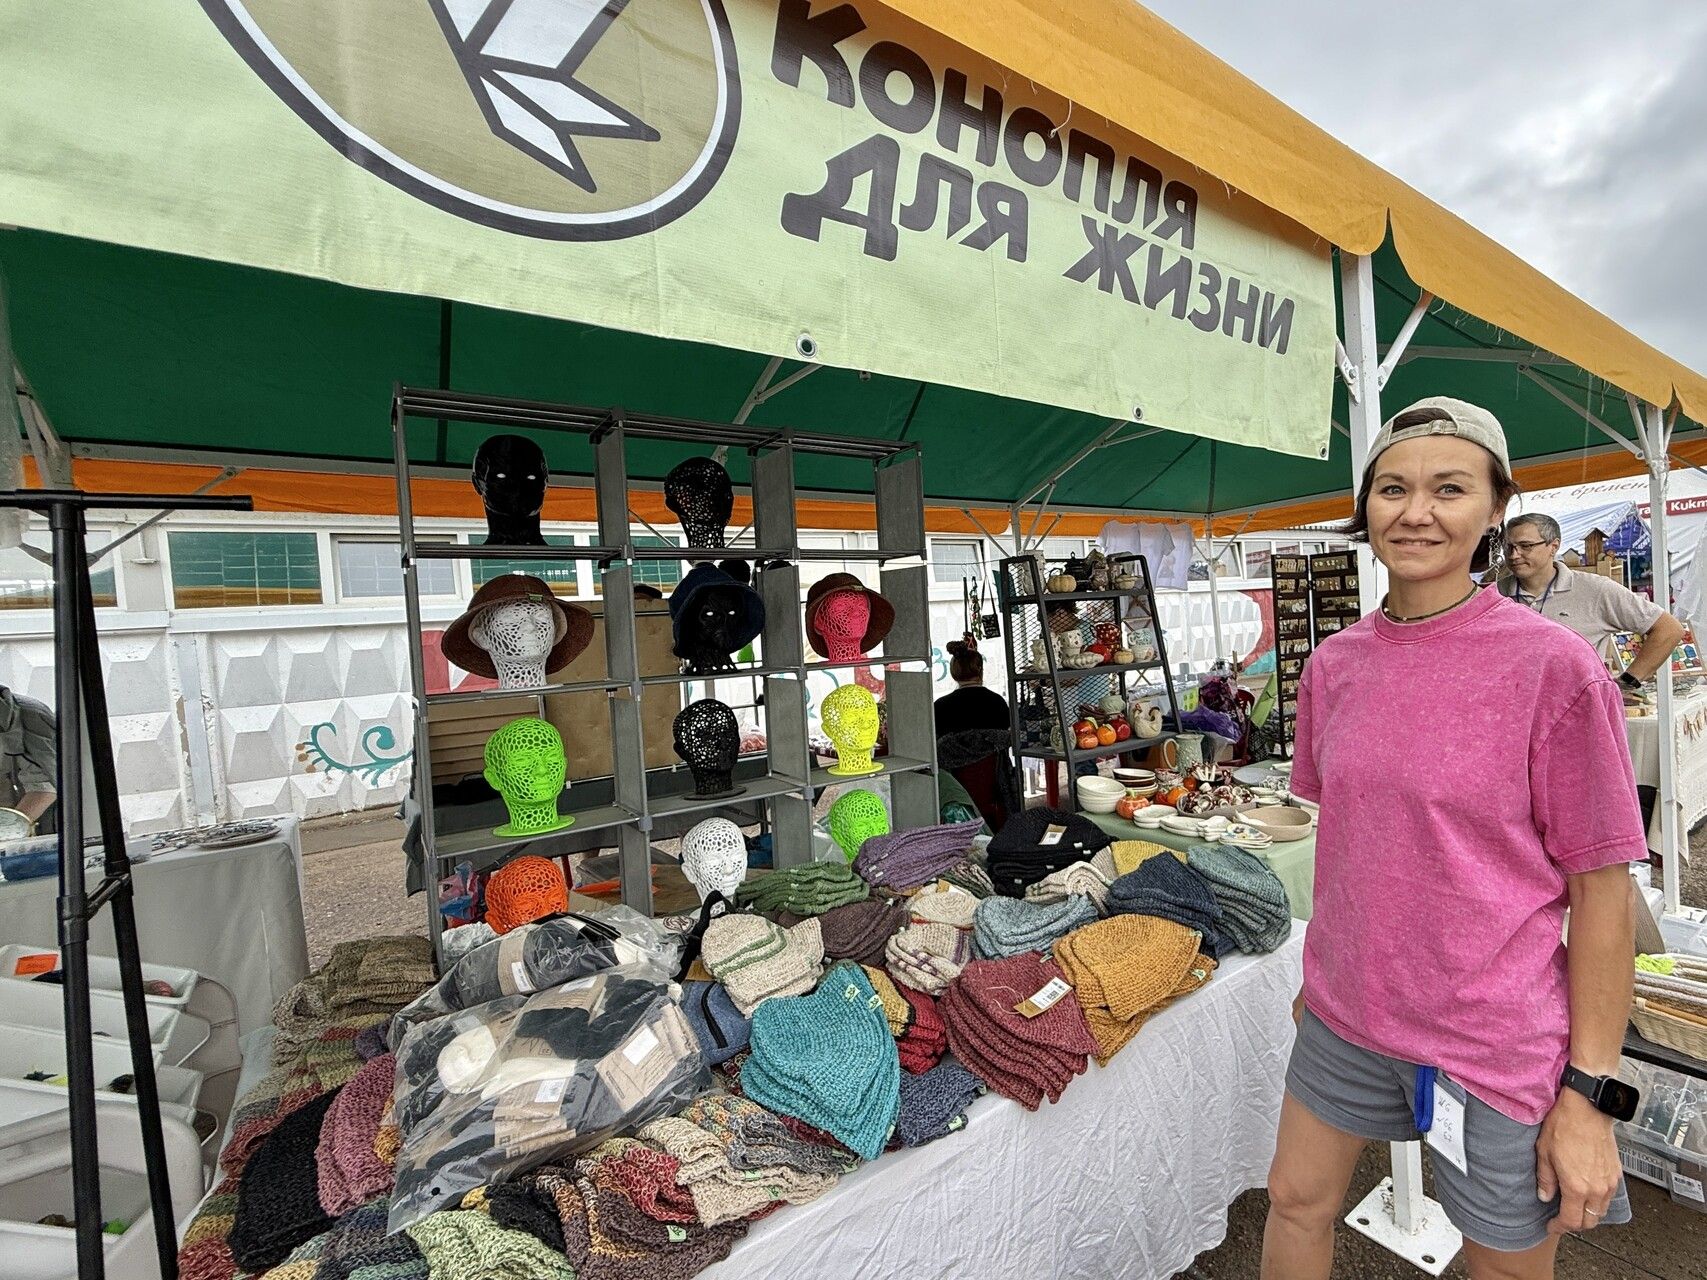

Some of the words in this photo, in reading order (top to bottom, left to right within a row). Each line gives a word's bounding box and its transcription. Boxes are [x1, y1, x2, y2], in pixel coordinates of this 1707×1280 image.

[771, 0, 1198, 250] КОНОПЛЯ
[781, 134, 1029, 263] ДЛЯ
[1062, 215, 1295, 355] ЖИЗНИ
